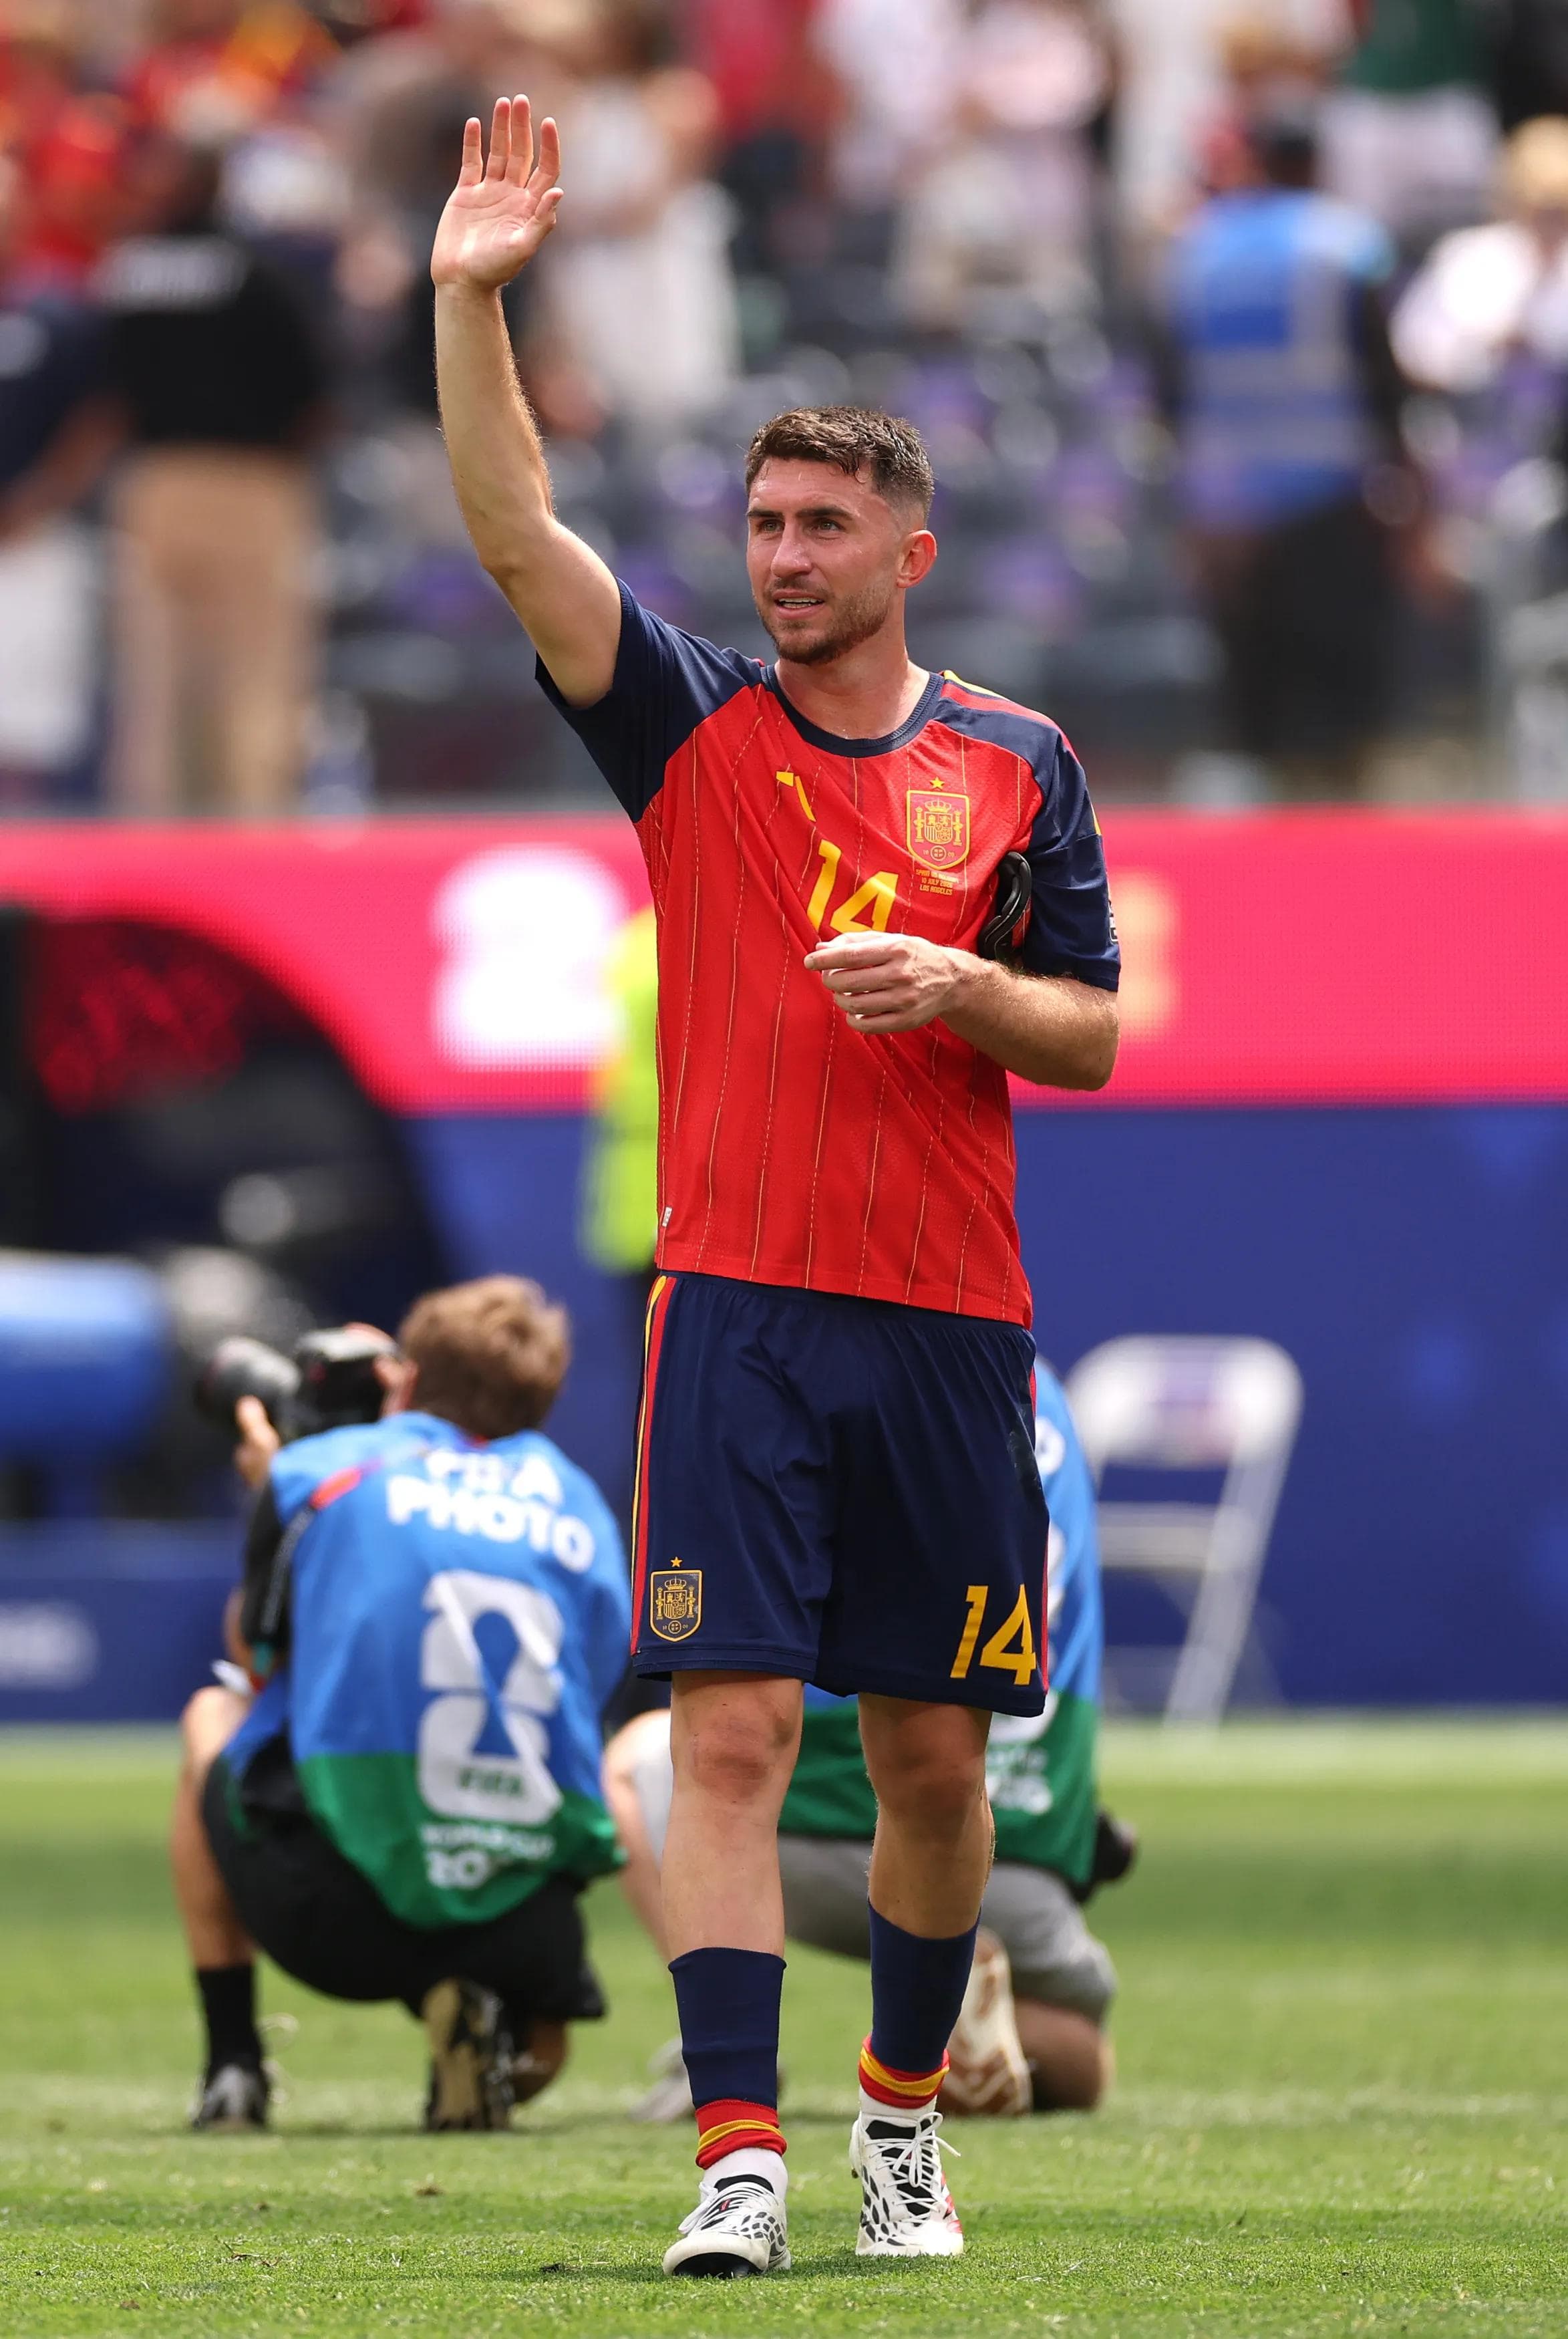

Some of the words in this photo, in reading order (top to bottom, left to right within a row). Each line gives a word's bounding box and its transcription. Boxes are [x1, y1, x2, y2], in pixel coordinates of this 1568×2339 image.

[806, 839, 899, 933] 14
[919, 883, 930, 891] LOS
[928, 877, 939, 885] JULY
[385, 1475, 595, 1572] PHOTO
[950, 1584, 1036, 1685] 14
